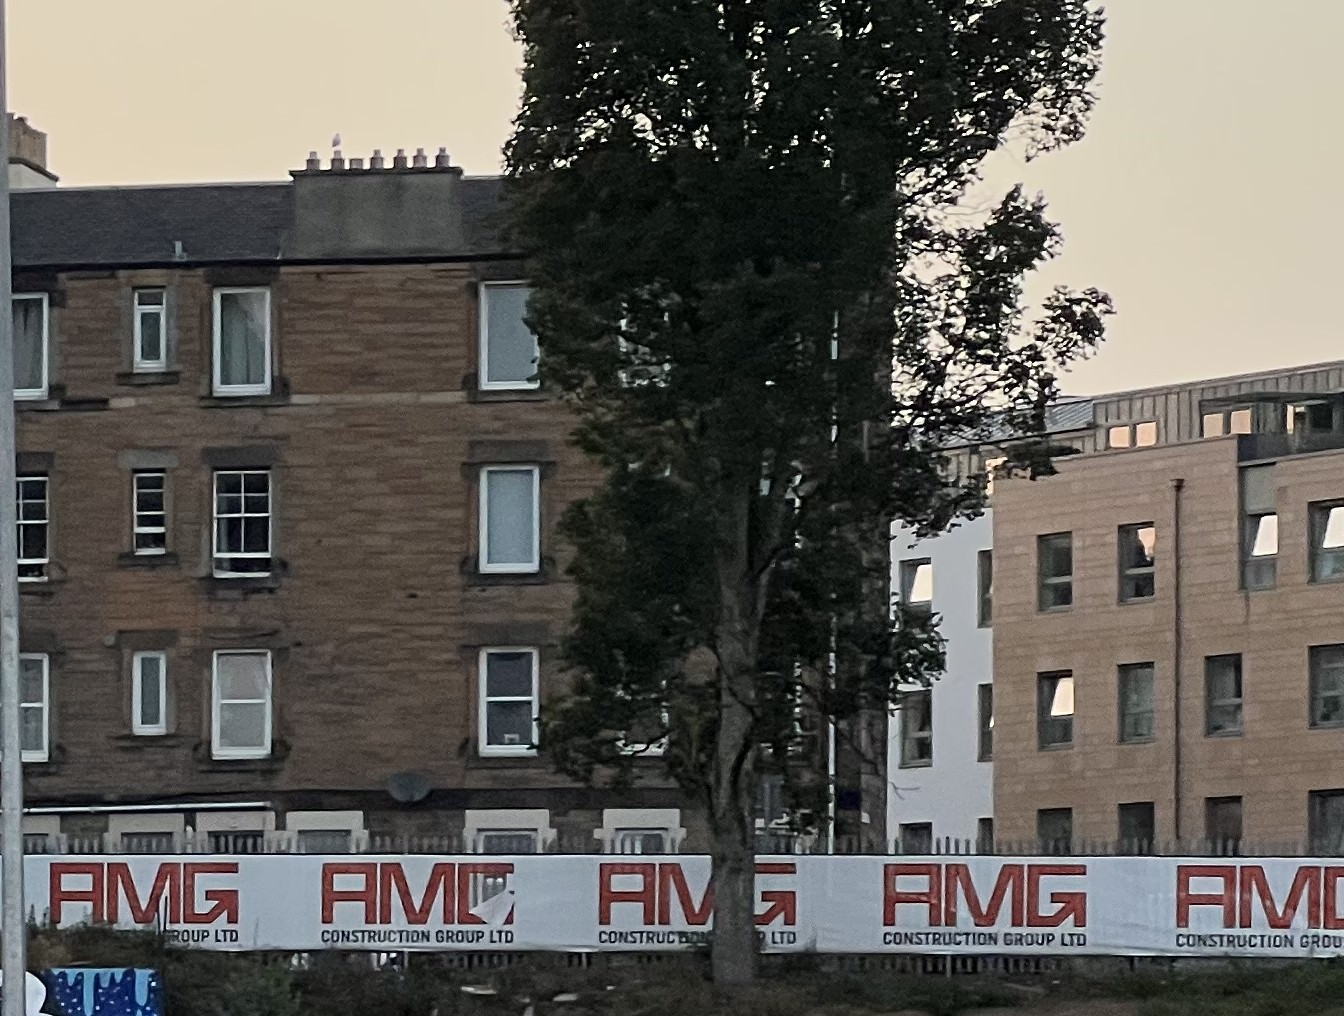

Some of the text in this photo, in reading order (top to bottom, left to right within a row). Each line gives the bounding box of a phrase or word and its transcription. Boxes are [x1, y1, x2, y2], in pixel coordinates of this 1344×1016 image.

[49, 862, 239, 925] AMG
[883, 864, 1087, 927] AMG
[215, 930, 238, 943] LTD
[322, 930, 514, 944] CONSTRUCTION GROUP LTD
[771, 931, 797, 945] LTD
[883, 932, 1087, 947] CONSTRUCTION GROUP LTD
[1176, 934, 1295, 948] CONSTRUCTION
